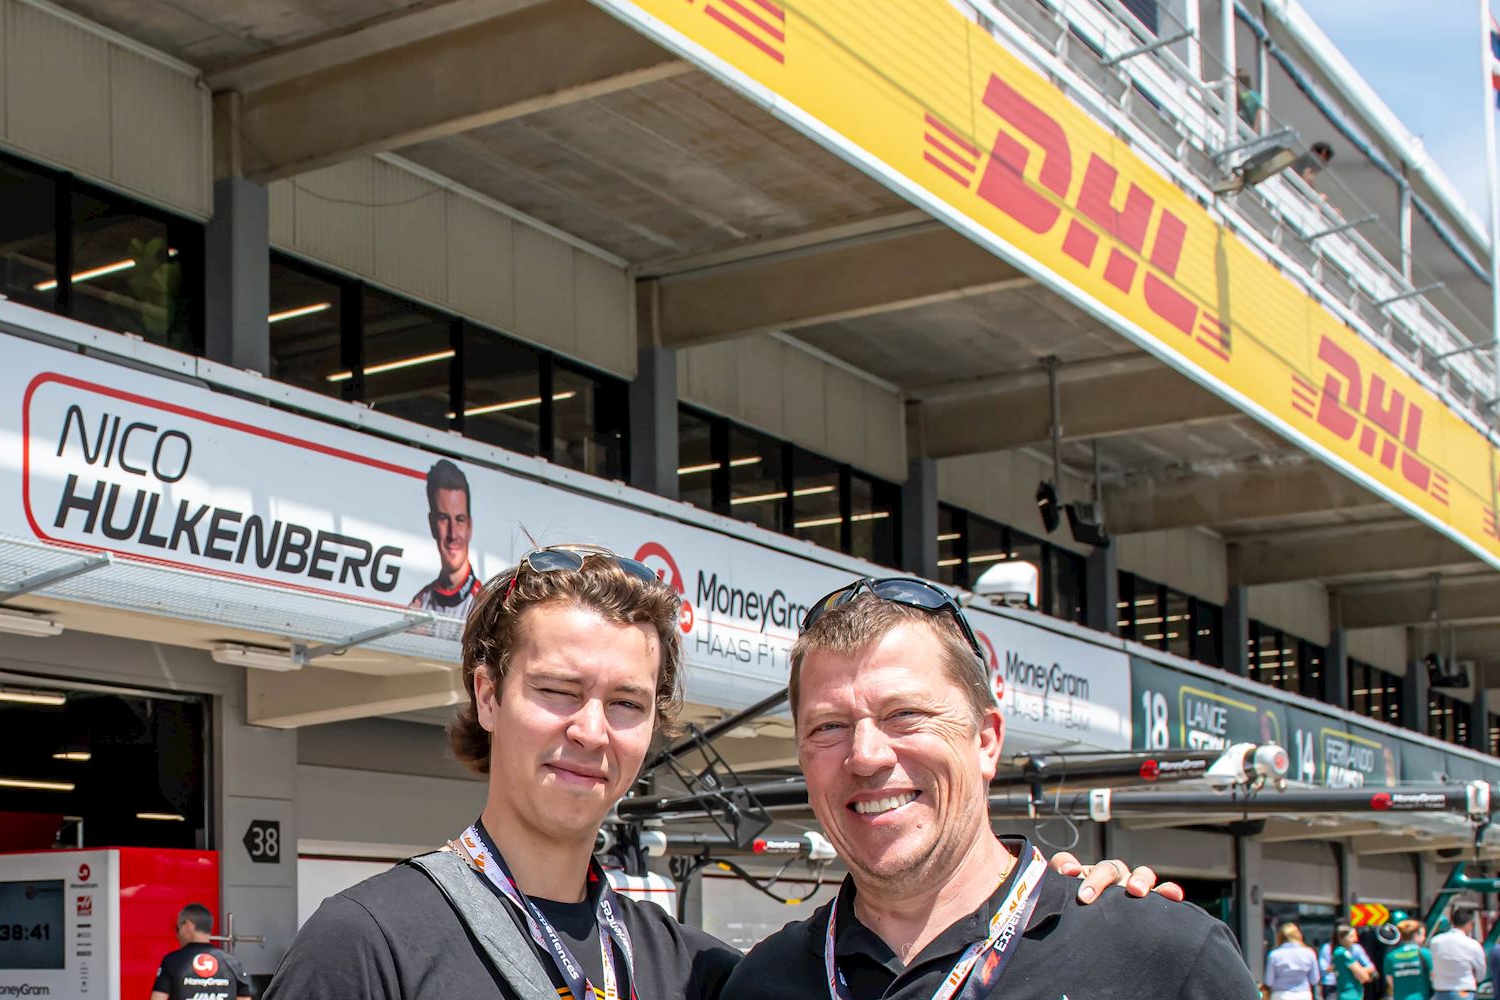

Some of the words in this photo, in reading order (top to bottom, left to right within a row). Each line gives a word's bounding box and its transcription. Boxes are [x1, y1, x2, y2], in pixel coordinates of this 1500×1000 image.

[977, 73, 1197, 336] DHL
[1318, 334, 1433, 489] DHL
[57, 403, 192, 483] NICO
[54, 474, 404, 592] HULKENBERG
[696, 628, 752, 662] HAAS
[757, 641, 778, 667] F1
[1005, 650, 1090, 700] MoneyGram
[1142, 689, 1170, 751] 18
[1186, 699, 1227, 735] LANCE
[1296, 728, 1316, 784] 14
[252, 826, 278, 857] 38
[184, 976, 229, 988] MoneyGram
